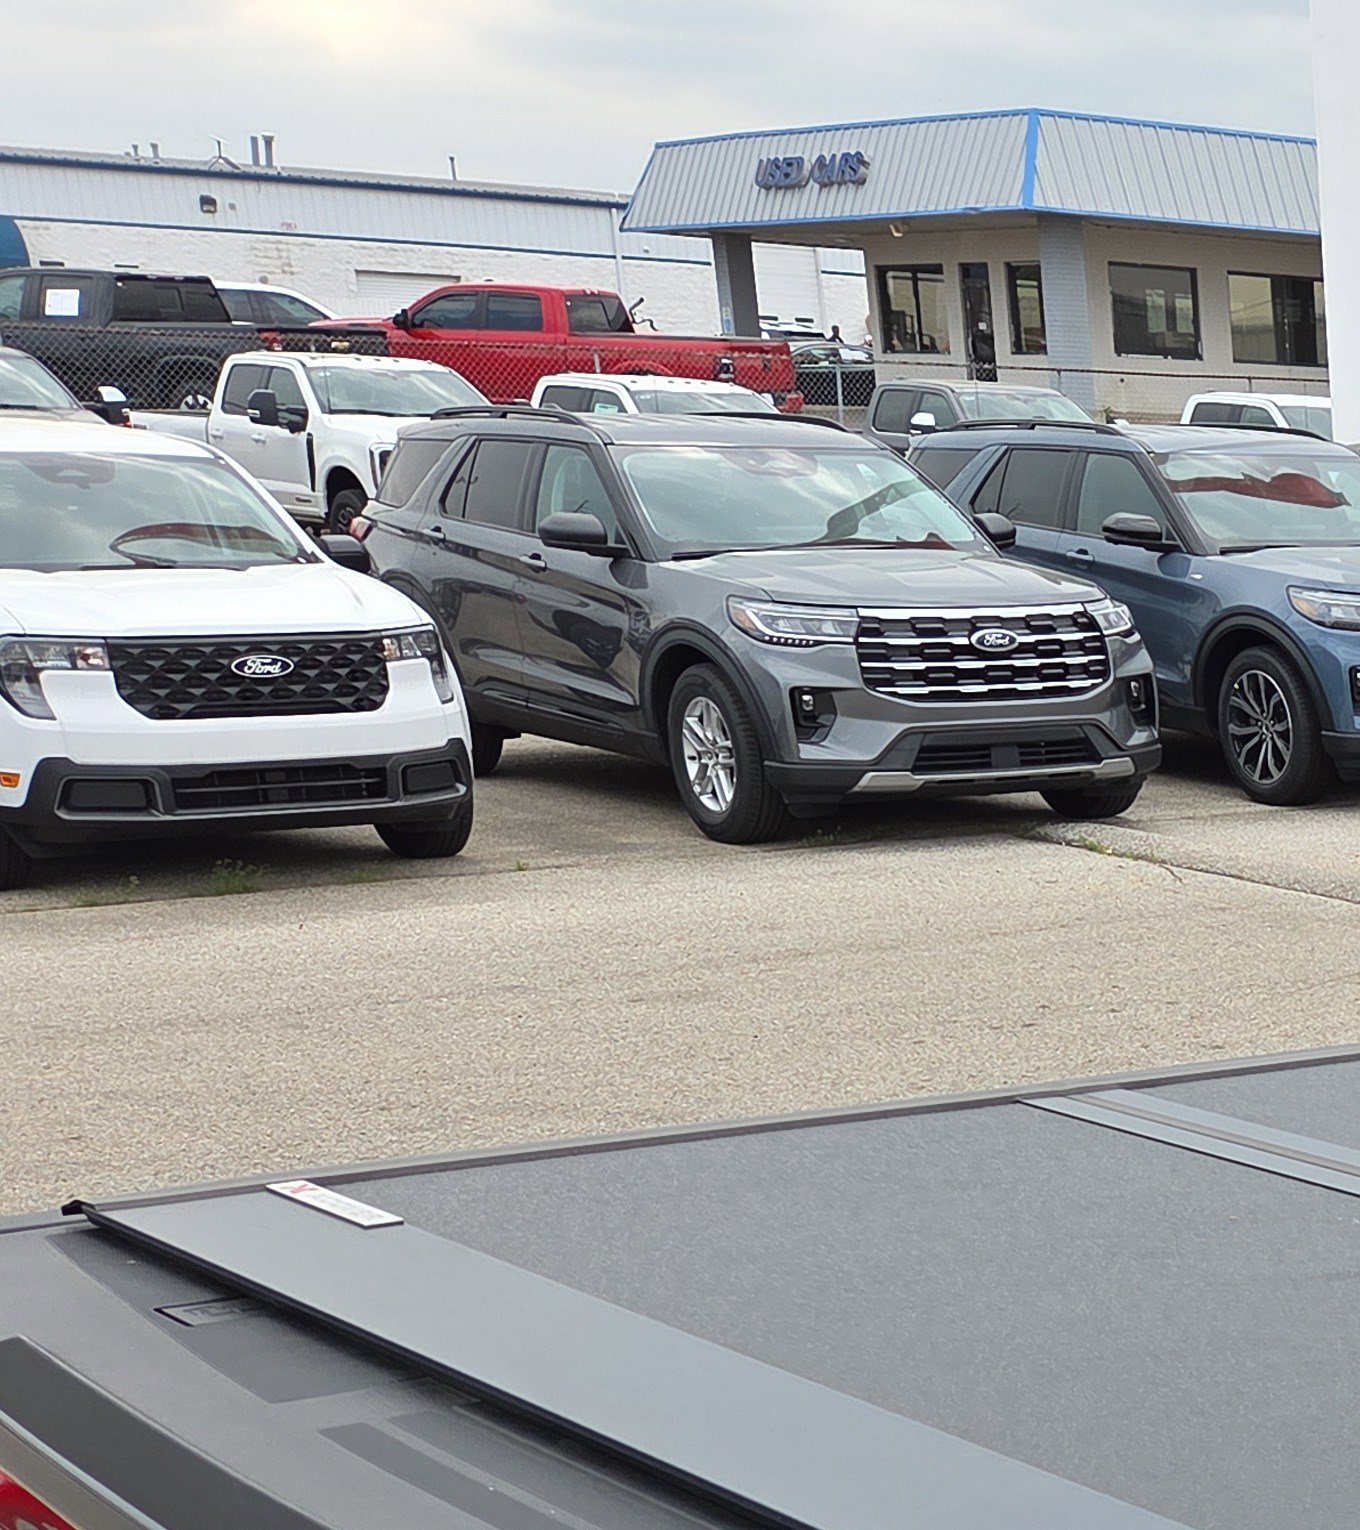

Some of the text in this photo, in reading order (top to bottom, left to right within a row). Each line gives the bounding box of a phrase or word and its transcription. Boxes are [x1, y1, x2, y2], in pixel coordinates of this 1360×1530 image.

[755, 151, 870, 190] USED CARS
[984, 633, 1010, 646] Ford
[243, 658, 282, 674] Ford
